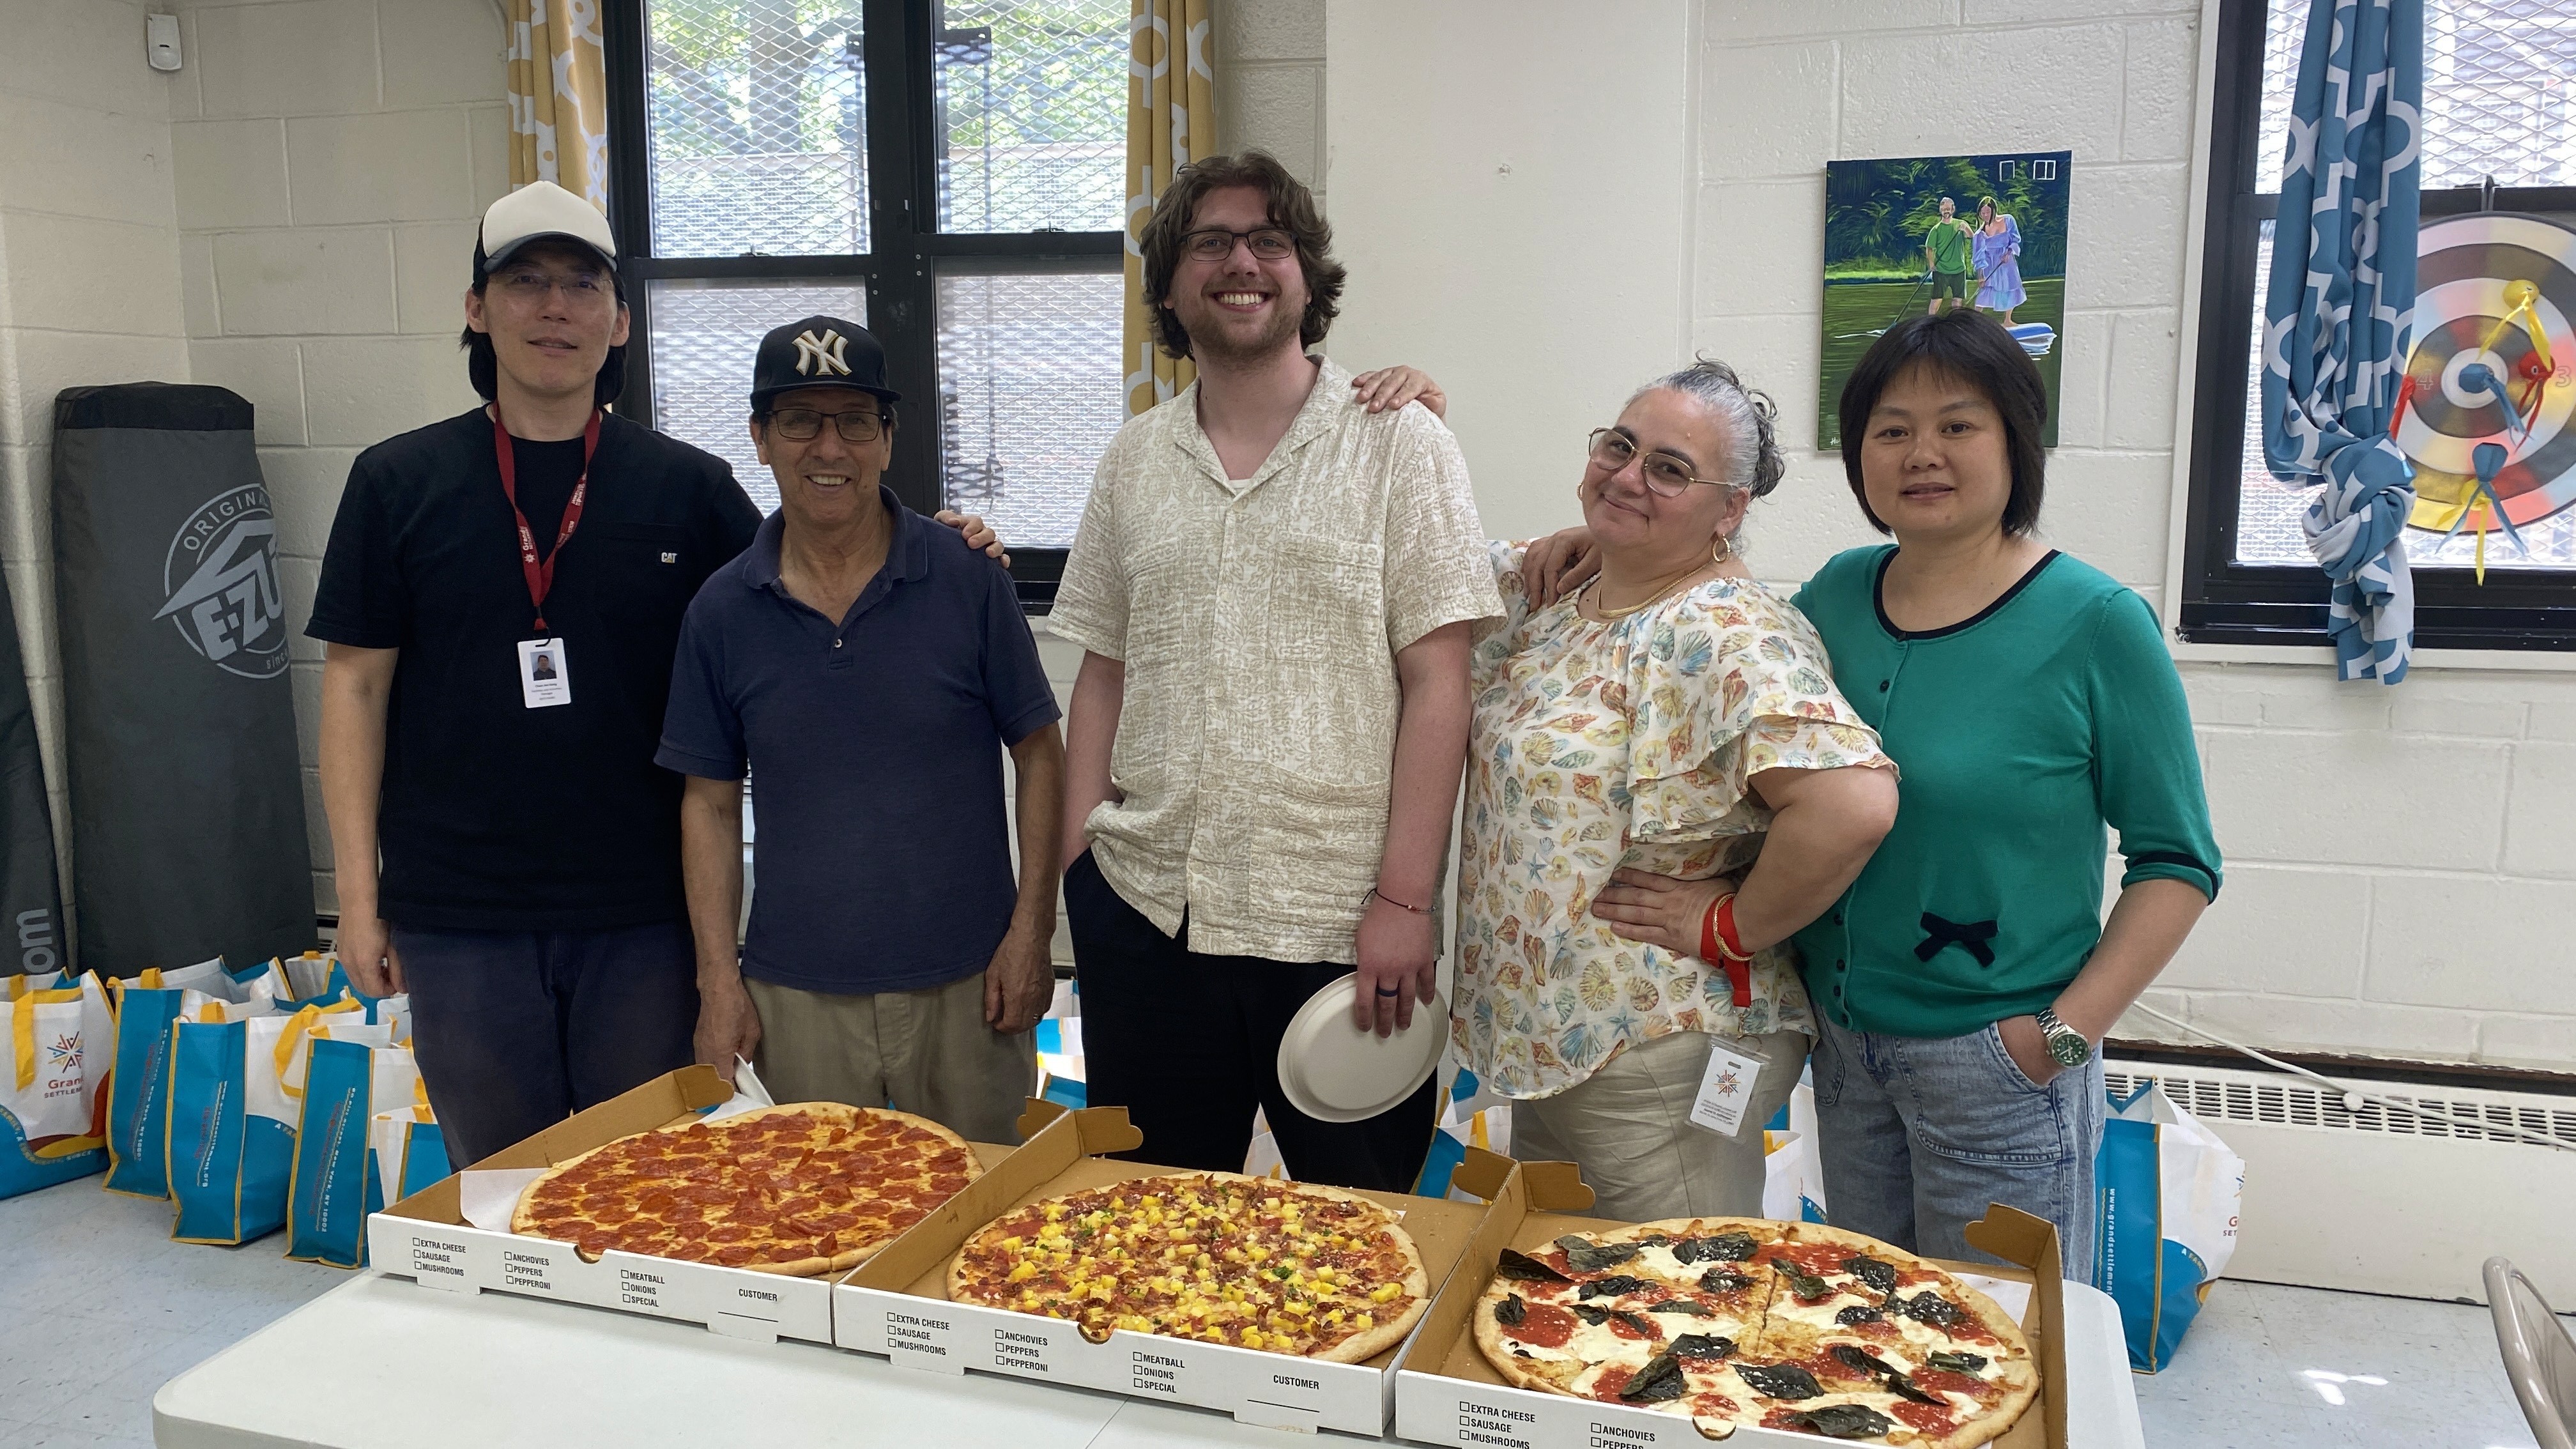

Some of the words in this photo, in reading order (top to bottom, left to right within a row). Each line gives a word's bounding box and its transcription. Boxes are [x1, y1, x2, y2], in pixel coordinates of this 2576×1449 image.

[792, 329, 852, 376] NY
[2416, 369, 2433, 390] 4
[2556, 366, 2572, 387] 3
[183, 491, 269, 550] ORIGINA
[661, 552, 677, 563] CAT
[16, 908, 55, 973] om
[44, 1087, 82, 1098] SETTLEM
[2229, 1216, 2238, 1227] G
[421, 1239, 441, 1250] EXTRA
[442, 1243, 466, 1254] CHEESE
[2106, 1188, 2115, 1296] www.grandsettlement
[422, 1252, 451, 1263] SAUSAGE
[512, 1254, 549, 1266] ANCHOVIES
[422, 1263, 464, 1276] MUSHROOMS
[514, 1265, 543, 1277] PEPPERS
[514, 1278, 551, 1290] PEPPERONI
[629, 1271, 666, 1284] MEATBALL
[631, 1284, 657, 1295] ONIONS
[739, 1289, 778, 1301] CUSTOMER
[631, 1296, 659, 1307] SPECIAL
[896, 1314, 920, 1326] EXTRA
[922, 1319, 950, 1330] CHEESE
[896, 1328, 931, 1340] SAUSAGE
[1004, 1332, 1048, 1346] ANCHOVIES
[897, 1340, 947, 1356] MUSHROOMS
[1005, 1345, 1040, 1358] PEPPERS
[1006, 1358, 1048, 1372] PEPPERONI
[1143, 1354, 1186, 1368] MEATBALL
[1144, 1367, 1174, 1380] ONIONS
[1144, 1381, 1177, 1393] SPECIAL
[1273, 1374, 1320, 1390] CUSTOMER
[1471, 1404, 1499, 1417] EXTRA
[1501, 1409, 1535, 1423] CHEESE
[1471, 1418, 1512, 1433] SAUSAGE
[1471, 1432, 1530, 1449] MUSHROOMS
[1602, 1425, 1656, 1442] ANCHOVIES
